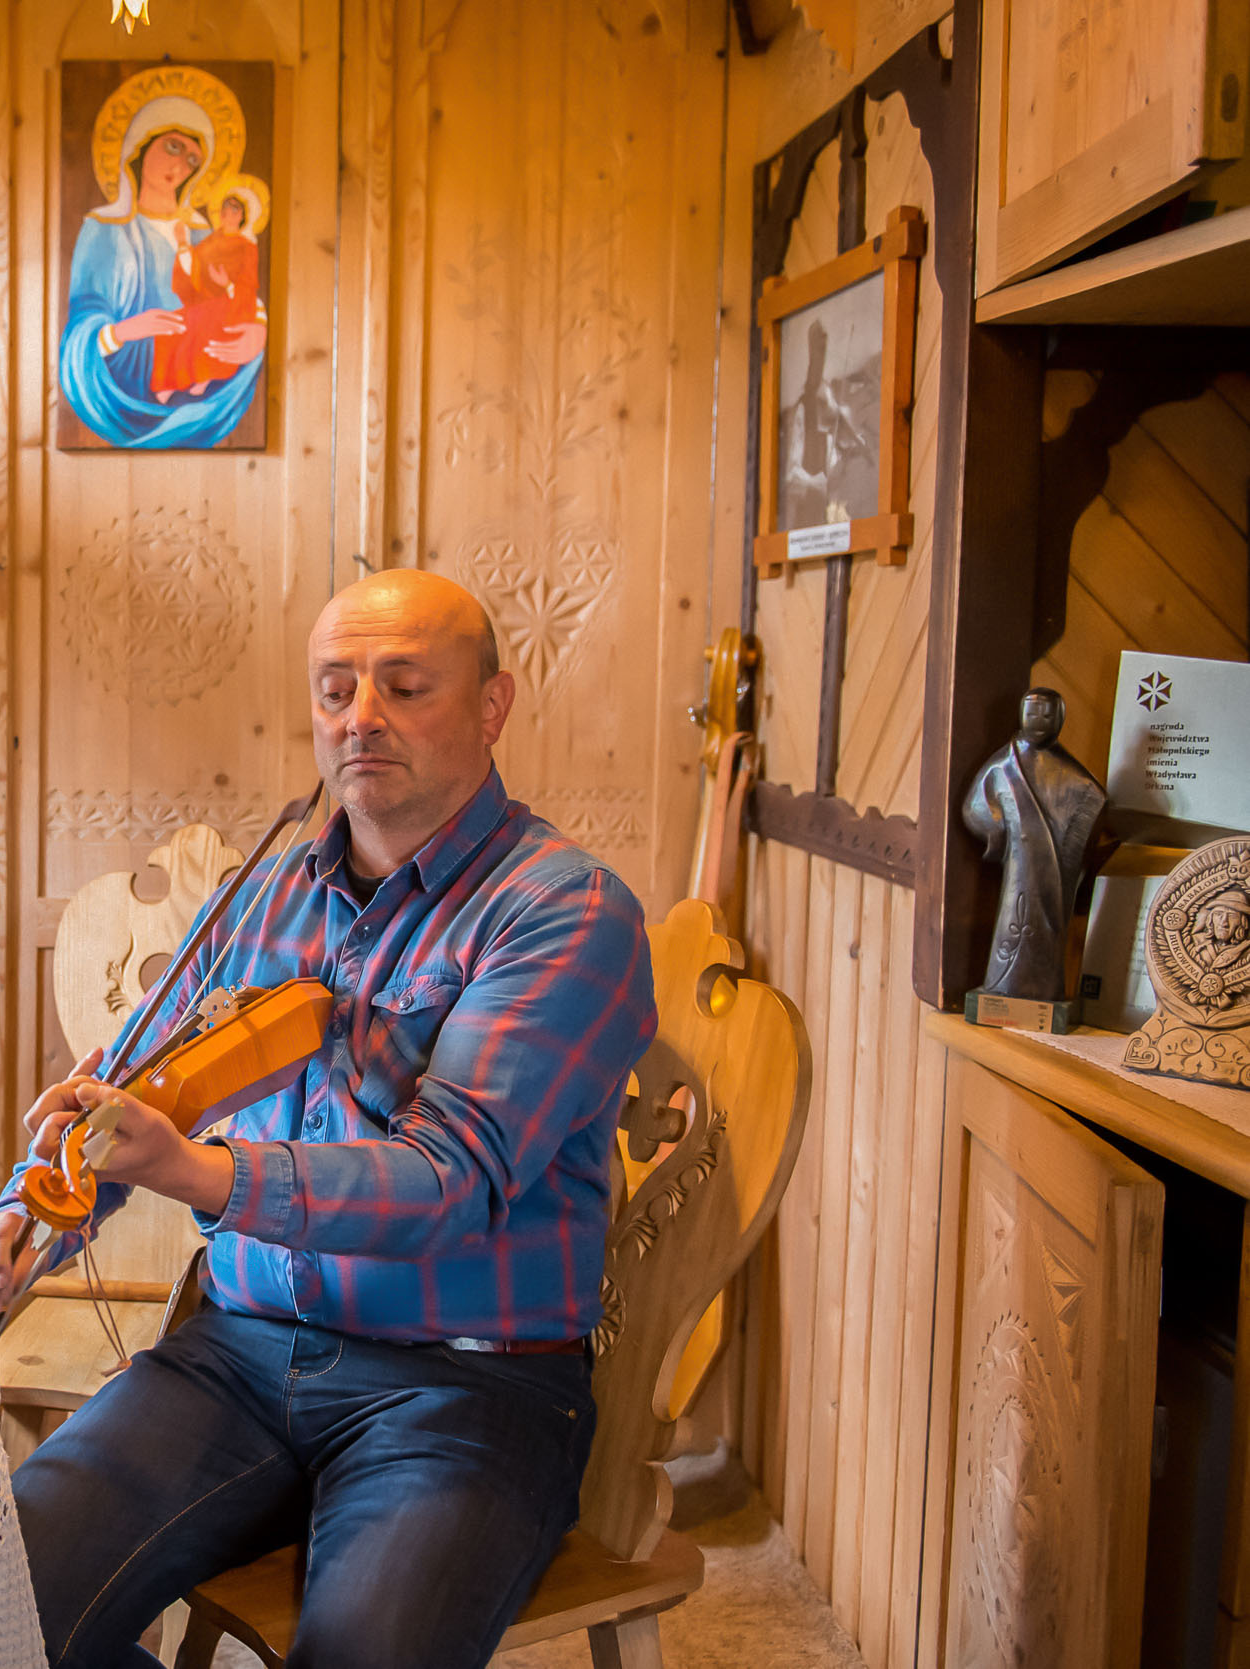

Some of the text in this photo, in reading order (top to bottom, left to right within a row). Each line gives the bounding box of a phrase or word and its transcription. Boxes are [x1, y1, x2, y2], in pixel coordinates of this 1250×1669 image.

[1150, 722, 1184, 732] nagroda
[1149, 734, 1209, 743] Województwa
[1148, 746, 1210, 757] Małopolskiego
[1146, 758, 1178, 767] imienia
[1145, 769, 1197, 781] Władysława
[1169, 934, 1200, 979] BUKOWINA
